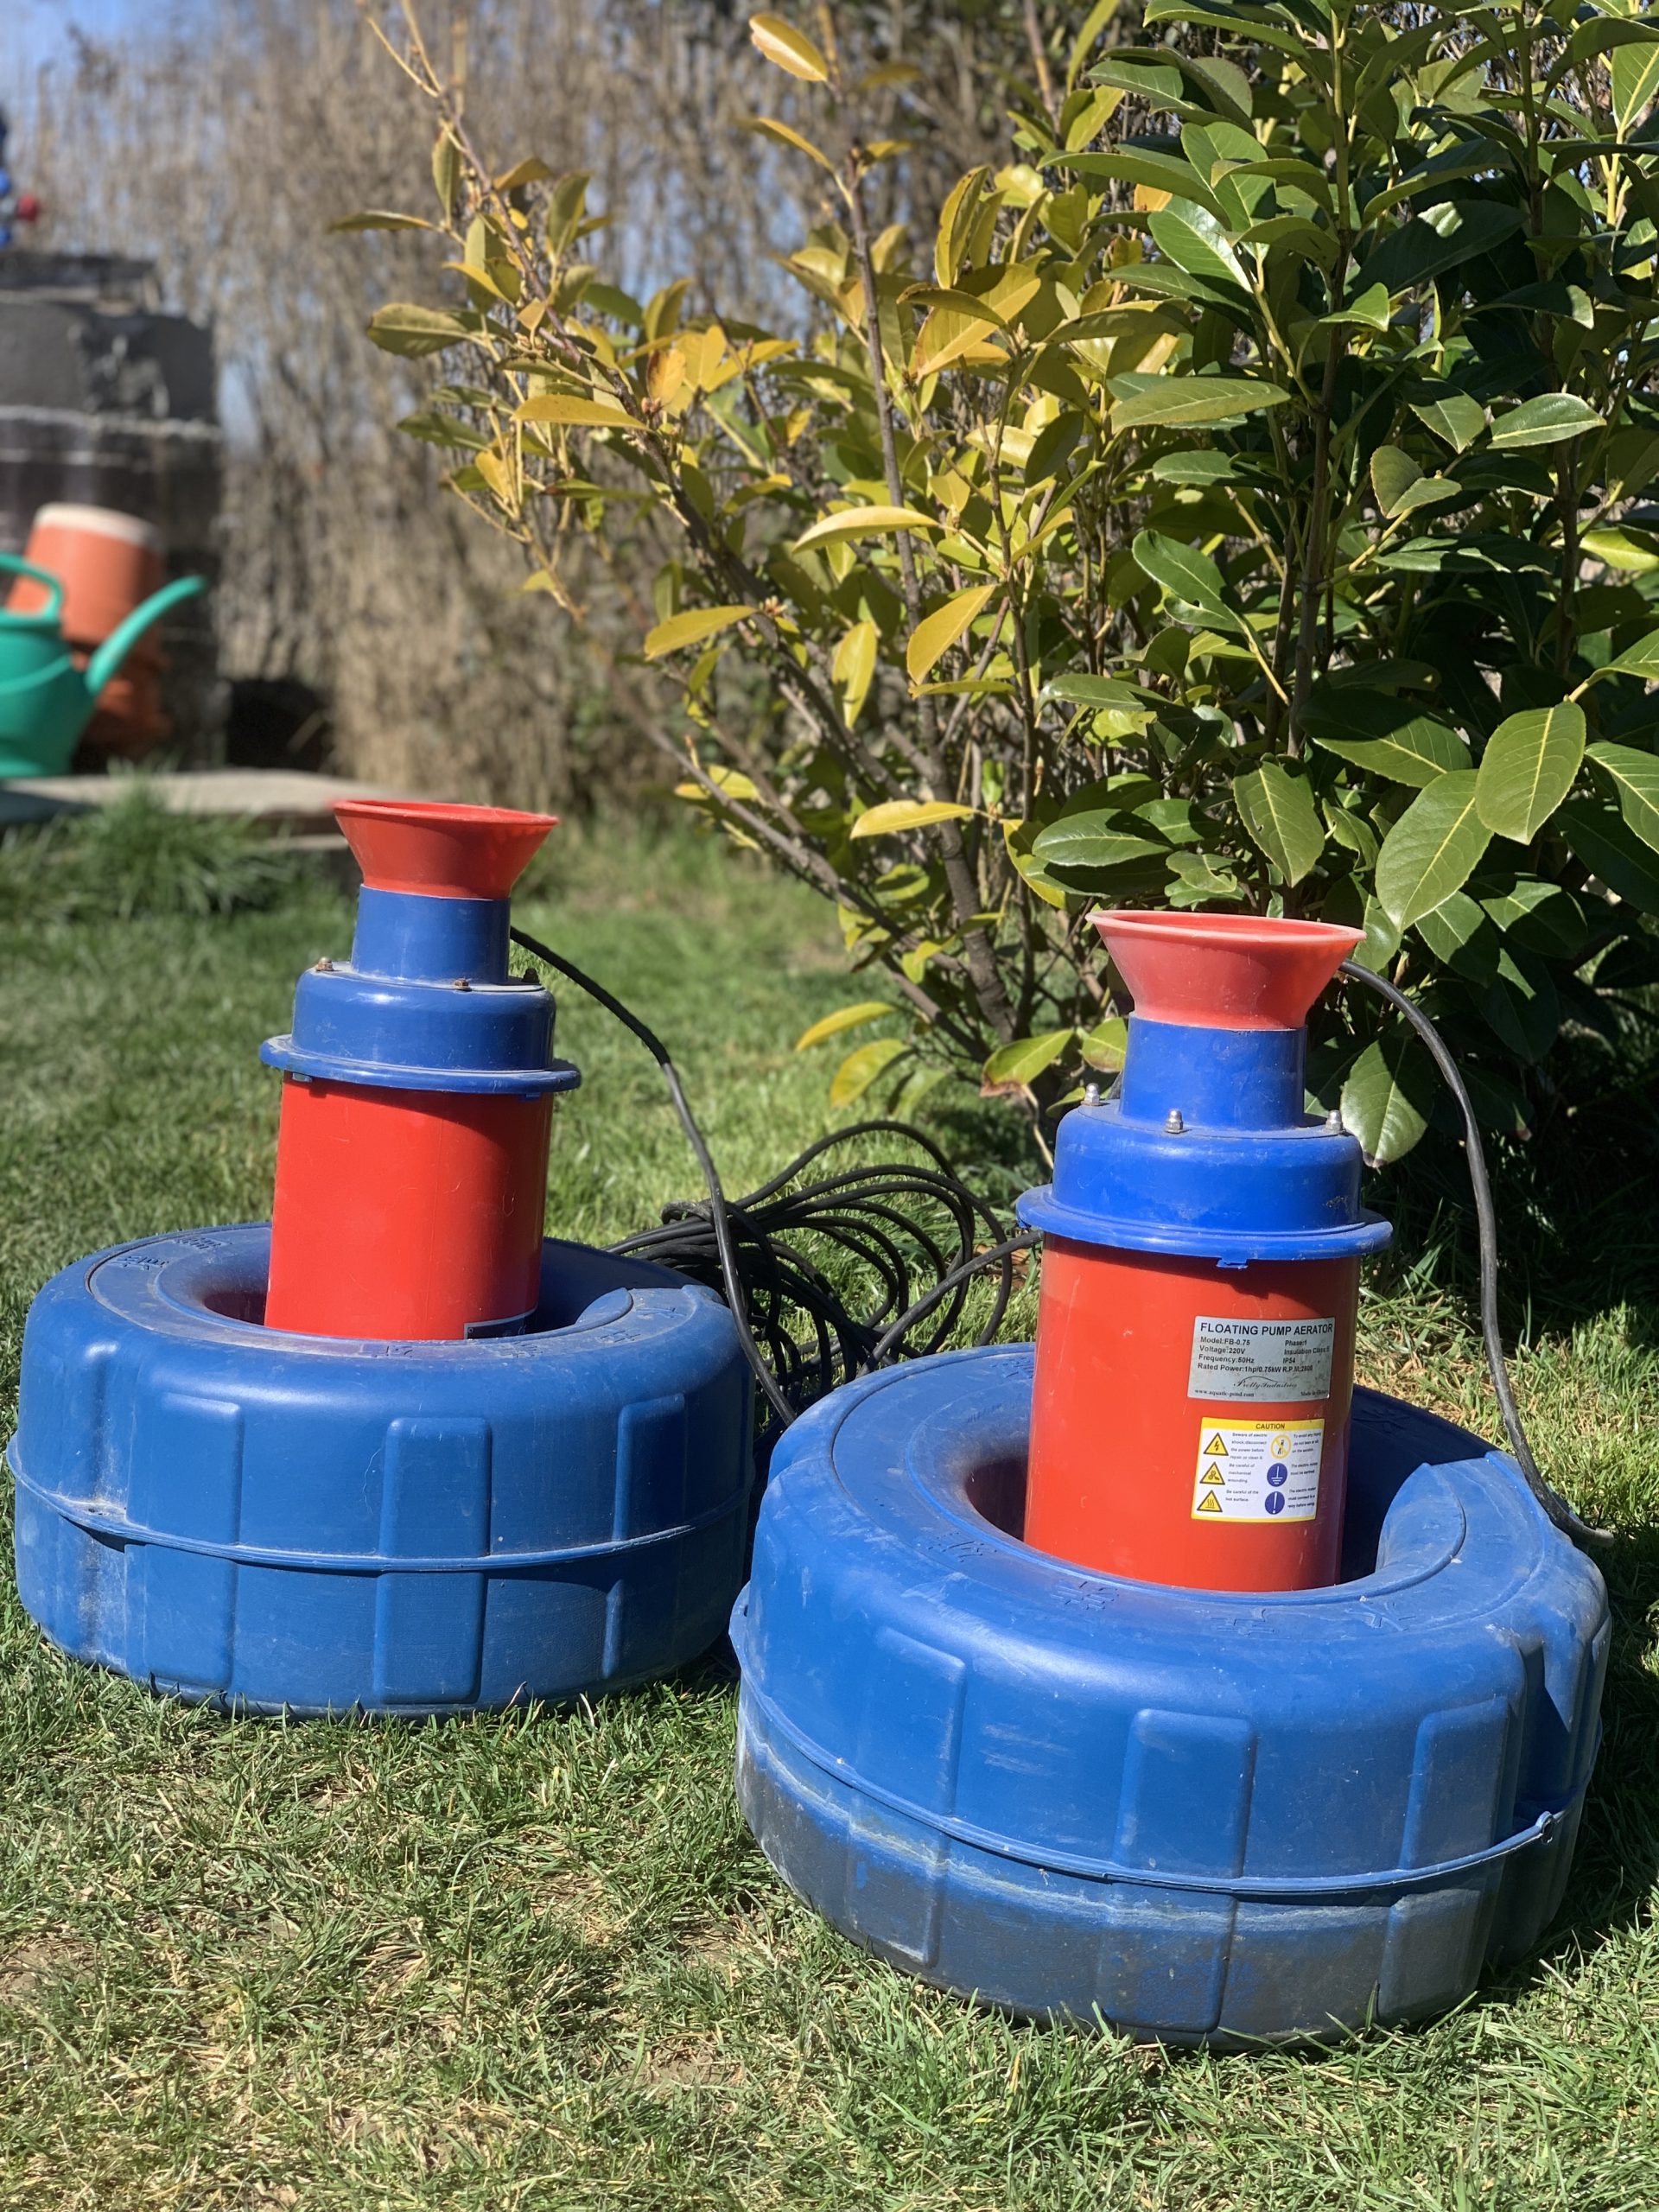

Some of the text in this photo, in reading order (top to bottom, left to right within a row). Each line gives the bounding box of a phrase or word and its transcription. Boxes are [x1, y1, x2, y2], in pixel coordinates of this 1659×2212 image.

[1200, 1322, 1332, 1336] FLOATING PUMP AERATOR
[1200, 1336, 1250, 1345] Model:FB-0.75
[1199, 1345, 1245, 1354] Voltage:220V
[1198, 1354, 1255, 1363] Frequency:50Hz
[1220, 1364, 1281, 1373] Power:1hp/0.75kW
